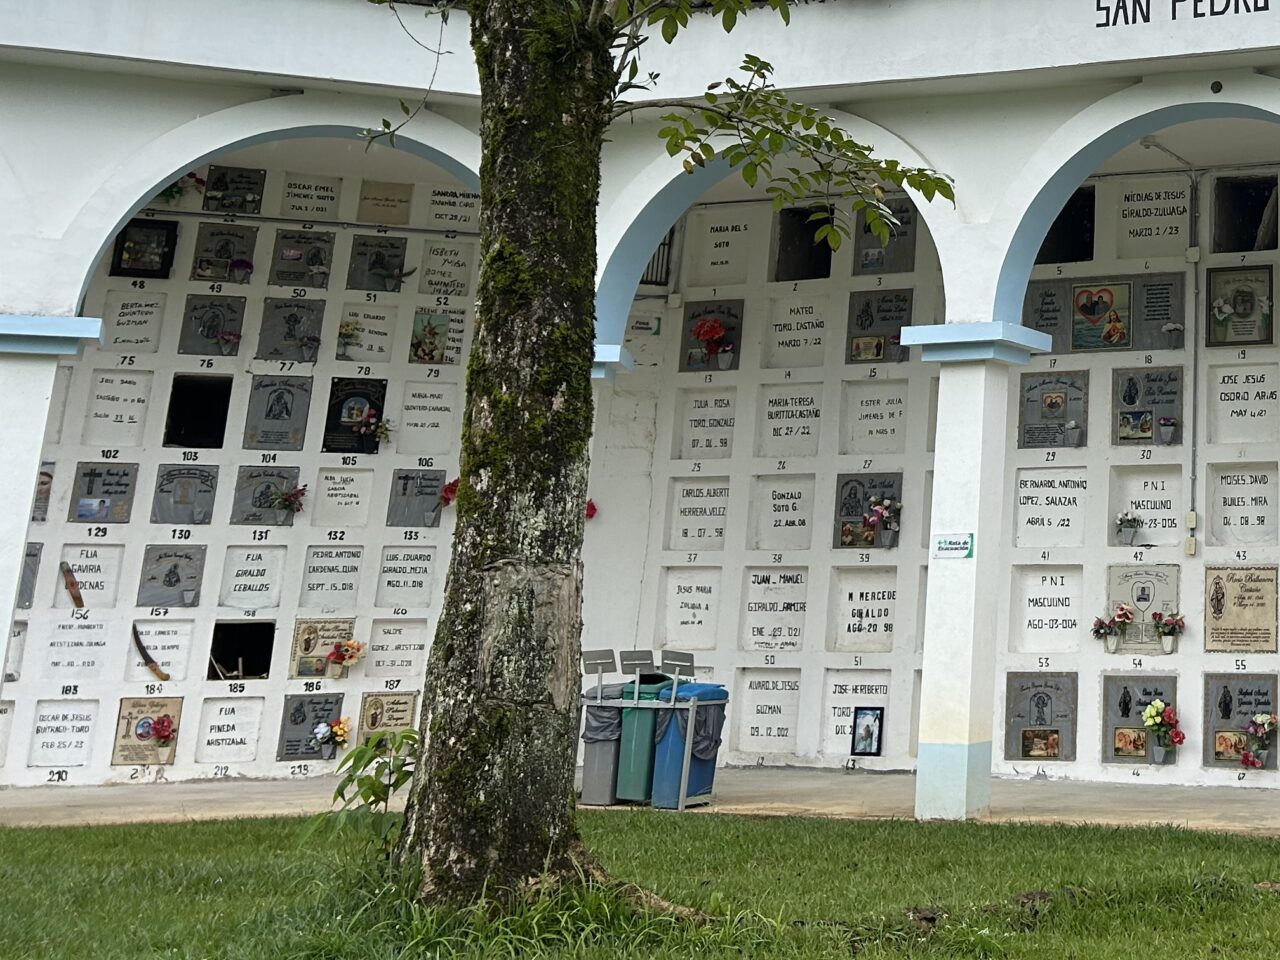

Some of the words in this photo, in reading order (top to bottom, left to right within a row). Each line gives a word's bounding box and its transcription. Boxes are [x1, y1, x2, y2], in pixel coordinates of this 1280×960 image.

[1163, 190, 1185, 199] JESUS
[1129, 228, 1152, 238] MARZO
[1057, 266, 1062, 275] 5
[131, 281, 145, 289] 48
[209, 284, 222, 293] 49
[789, 306, 813, 315] MATEO
[778, 339, 801, 348] MARZO
[200, 359, 214, 368] 76
[427, 369, 440, 378] 79
[784, 370, 791, 379] 14
[869, 368, 877, 377] 15
[704, 375, 713, 383] 13
[1219, 375, 1238, 384] JOSE
[1243, 374, 1266, 384] JESUS
[860, 399, 880, 407] ESTER
[1230, 409, 1247, 417] MAY
[101, 449, 119, 459] 102
[182, 451, 199, 461] 103
[261, 453, 277, 463] 104
[1045, 452, 1056, 461] 29
[341, 456, 357, 466] 105
[418, 457, 434, 467] 106
[863, 460, 873, 469] 27
[772, 490, 802, 500] GONZALO
[773, 503, 789, 512] SOTO
[88, 527, 108, 537] 129
[172, 529, 191, 540] 130
[328, 531, 345, 541] 132
[403, 531, 419, 541] 133
[772, 554, 782, 563] 38
[859, 553, 870, 562] 39
[1133, 552, 1143, 562] 42
[235, 569, 266, 577] GIRALDO
[233, 583, 270, 592] CEBALLOS
[859, 591, 897, 601] MERCEDE
[854, 656, 862, 666] 51
[1133, 659, 1142, 668] 54
[1235, 660, 1246, 670] 55
[385, 679, 401, 690] 187
[756, 705, 782, 714] GUZMAN
[209, 724, 236, 733] PINEDA
